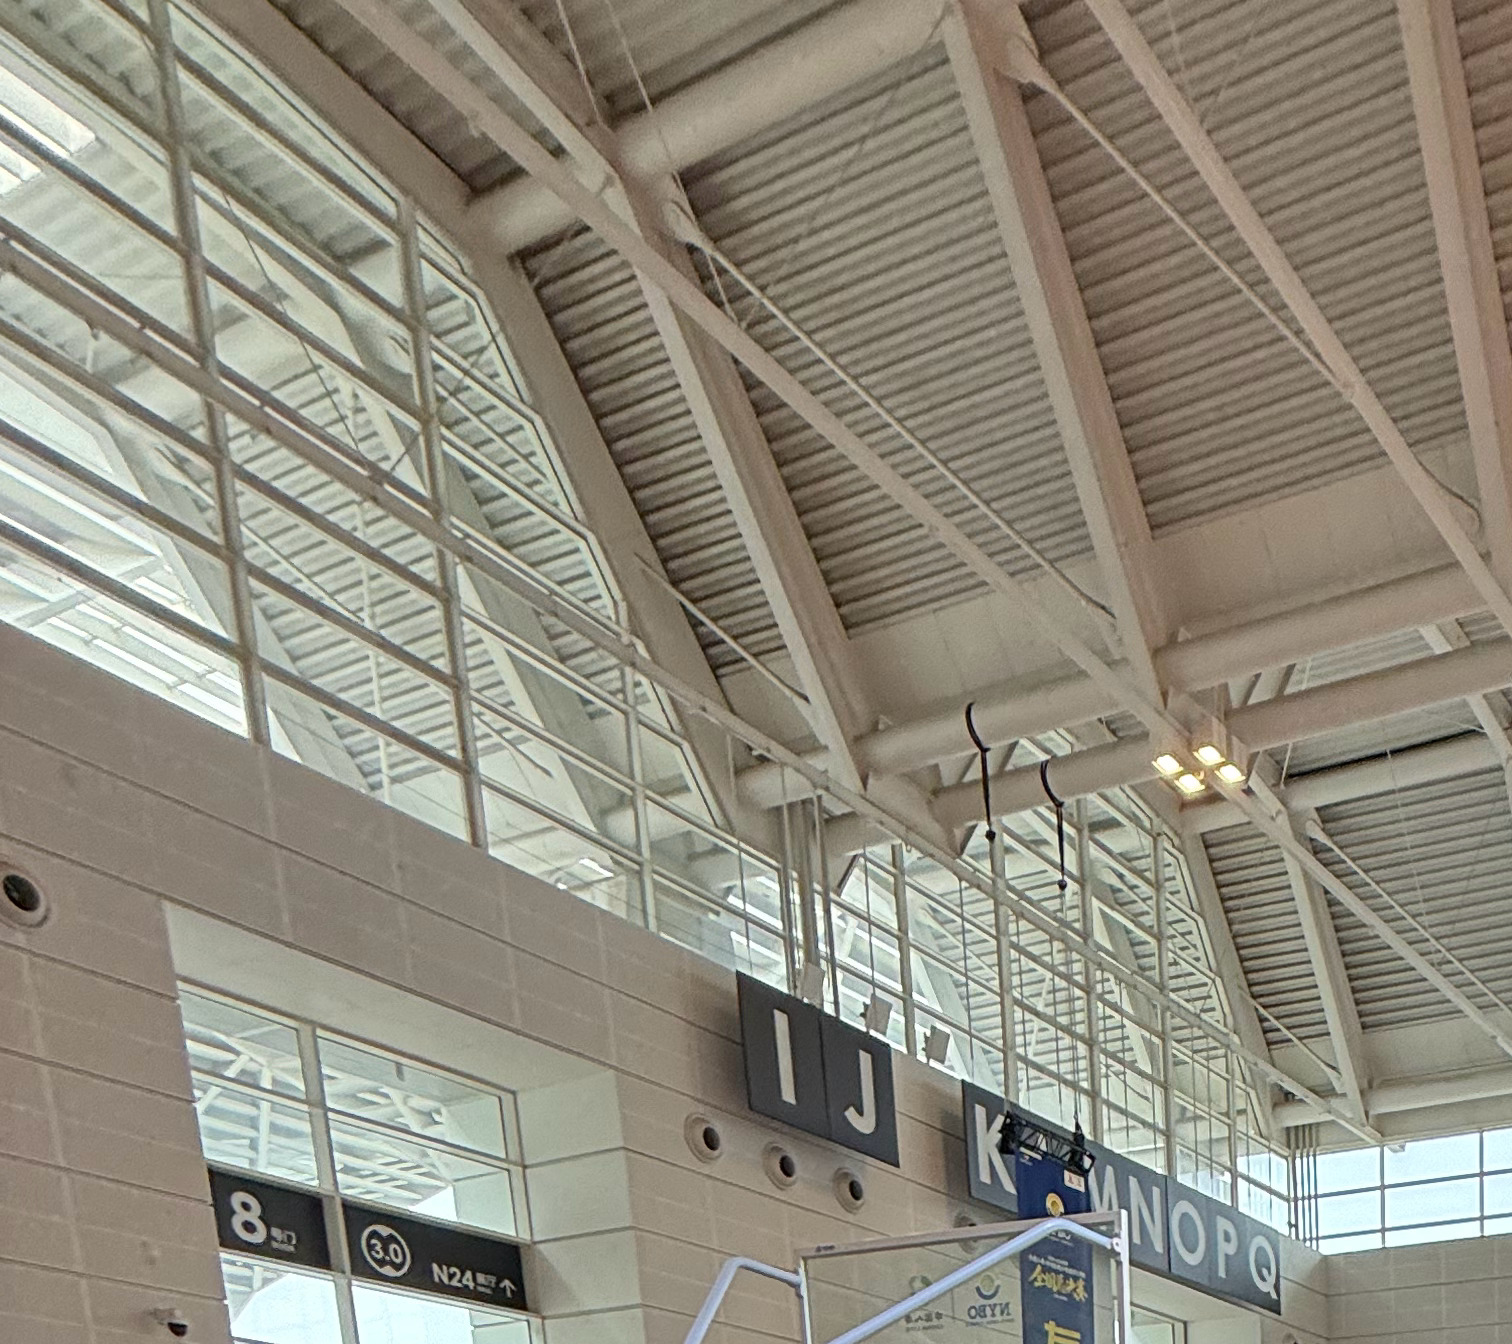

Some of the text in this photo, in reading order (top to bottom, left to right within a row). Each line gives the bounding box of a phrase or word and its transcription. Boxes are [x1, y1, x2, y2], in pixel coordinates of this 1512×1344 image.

[230, 1190, 267, 1245] 8
[368, 1239, 402, 1264] 3.0
[431, 1262, 475, 1290] N24
